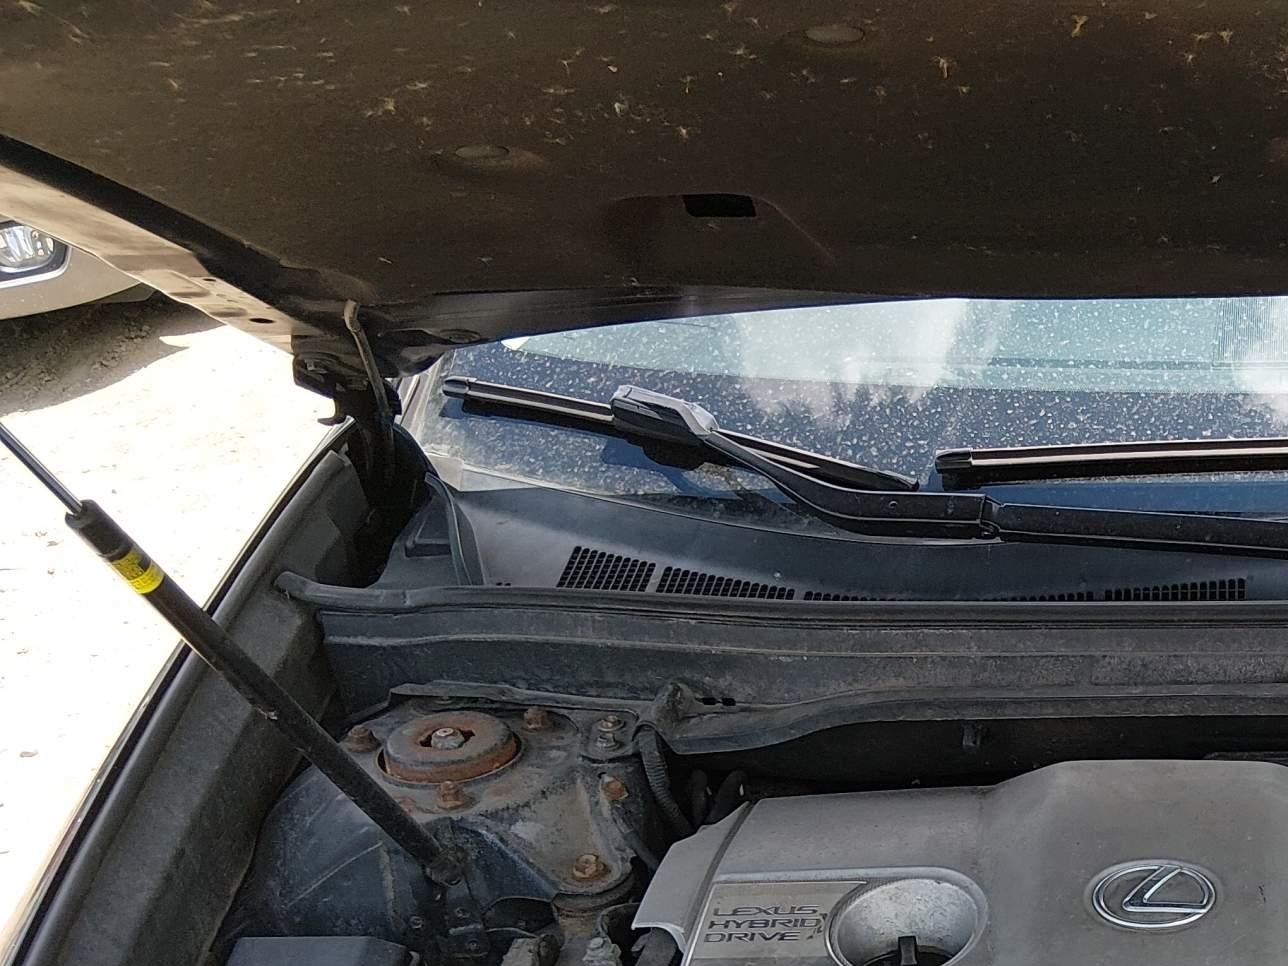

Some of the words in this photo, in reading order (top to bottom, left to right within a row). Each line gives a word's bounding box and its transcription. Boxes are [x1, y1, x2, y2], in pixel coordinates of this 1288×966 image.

[713, 906, 821, 916] LEXUS
[708, 918, 822, 929] HYBRID
[704, 931, 801, 942] DRIVE
